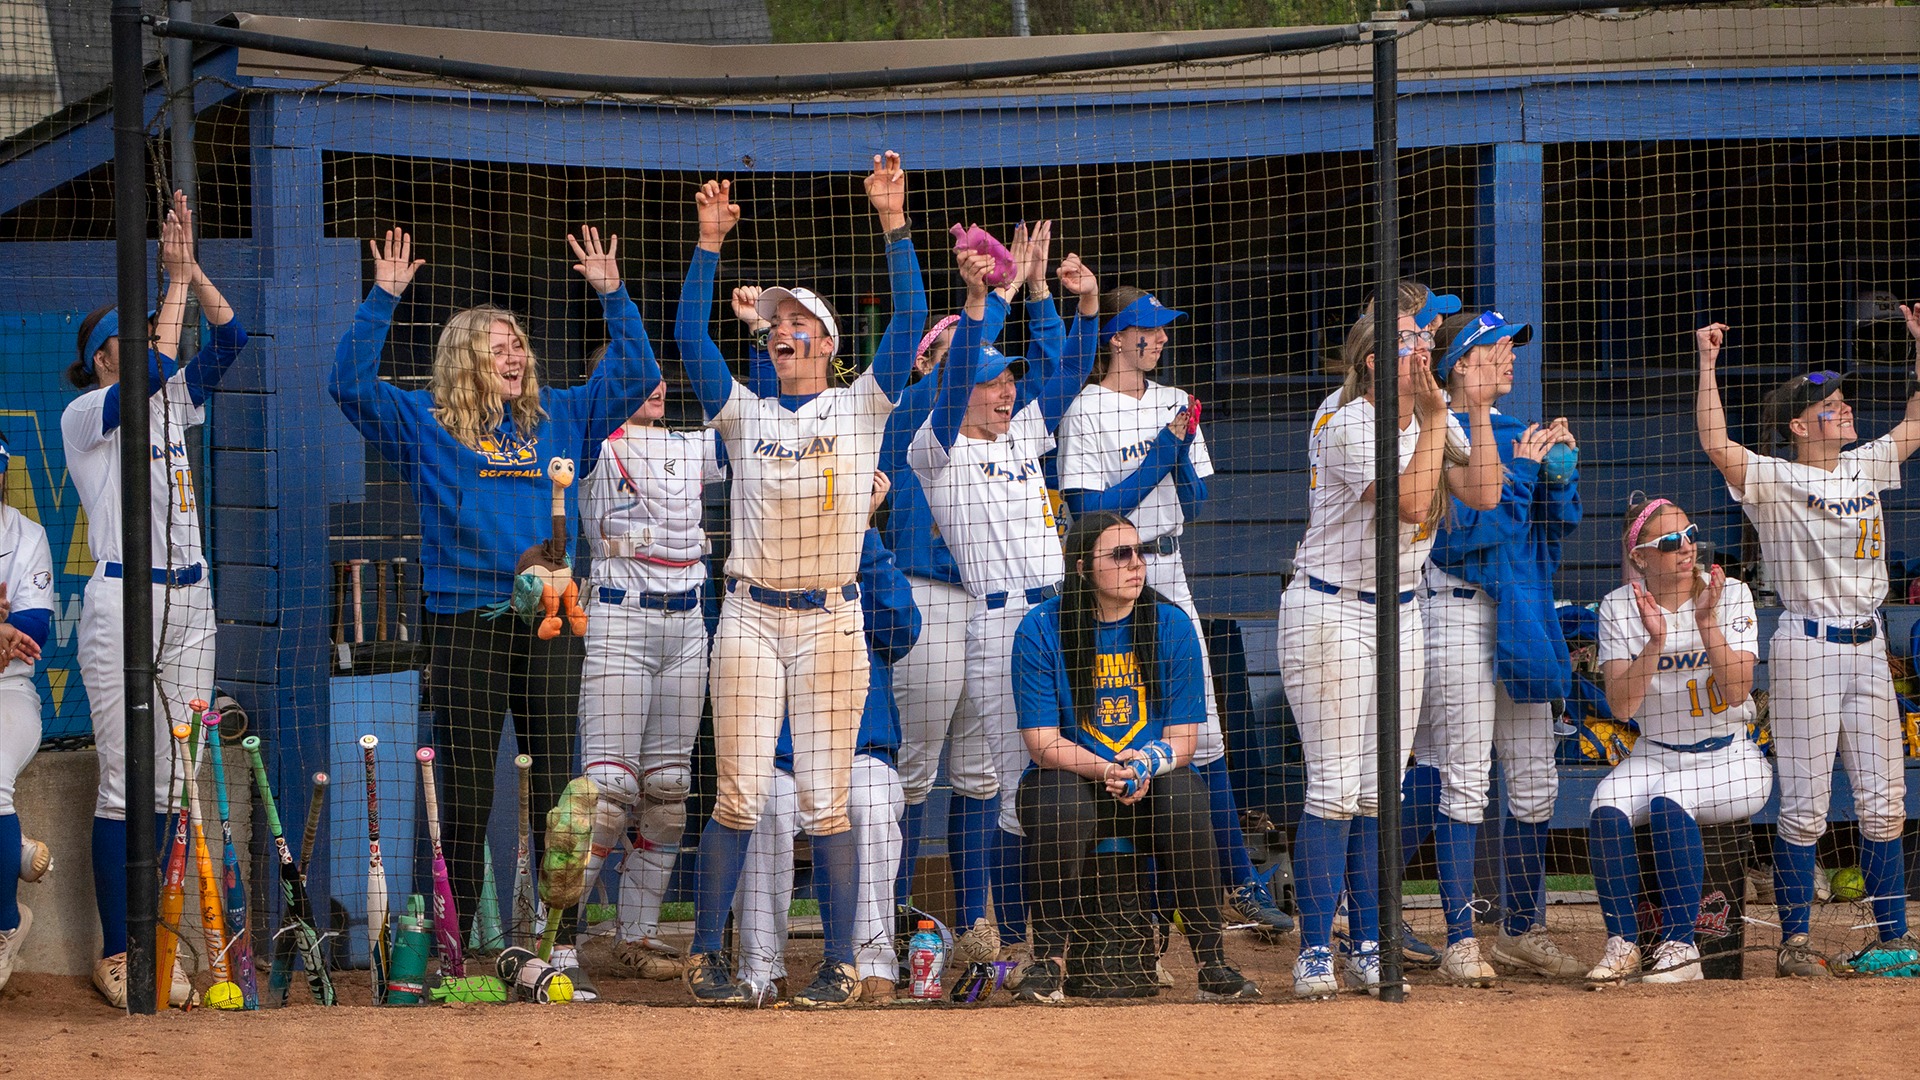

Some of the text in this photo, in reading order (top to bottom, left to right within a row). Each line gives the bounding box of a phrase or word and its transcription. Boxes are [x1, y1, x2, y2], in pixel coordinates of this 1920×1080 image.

[1121, 440, 1156, 462] MID
[479, 468, 543, 478] SOFTBALL
[822, 467, 835, 512] 1
[1656, 650, 1711, 672] DWA
[1093, 674, 1144, 689] FTBALL
[1686, 673, 1729, 717] 10
[1100, 706, 1131, 715] MIDWAY
